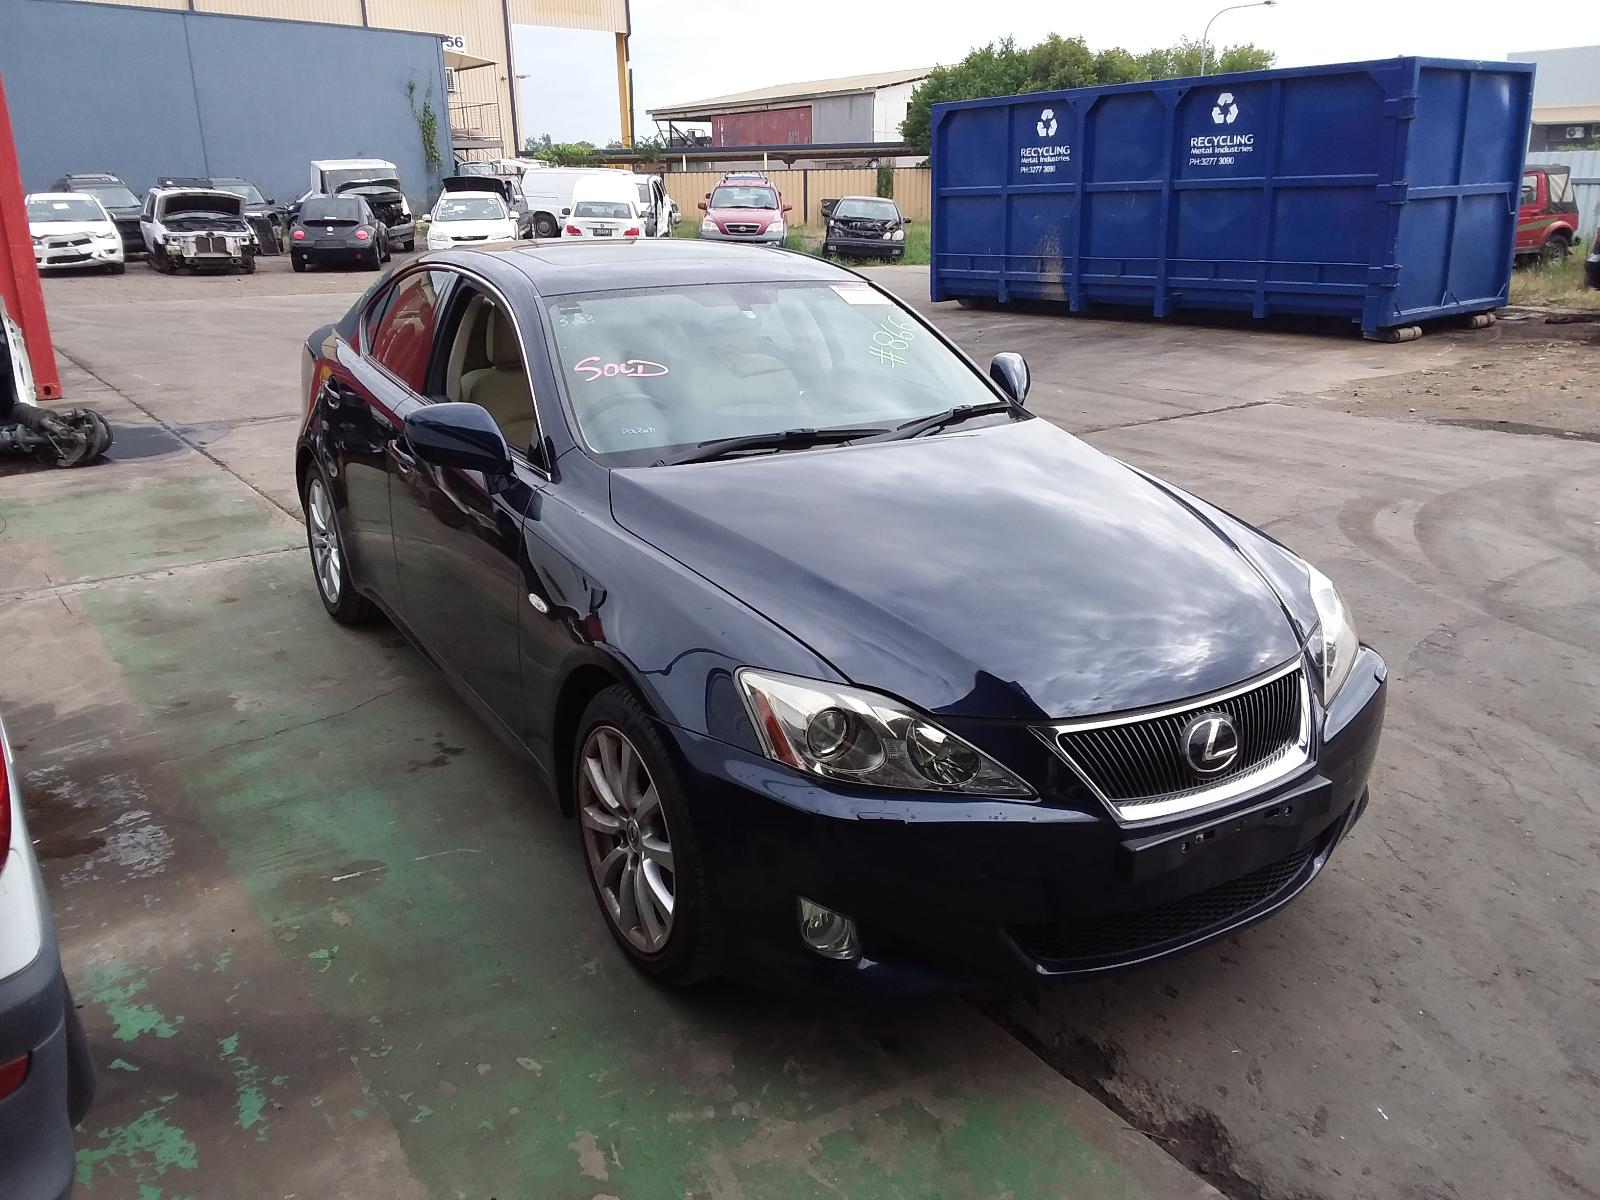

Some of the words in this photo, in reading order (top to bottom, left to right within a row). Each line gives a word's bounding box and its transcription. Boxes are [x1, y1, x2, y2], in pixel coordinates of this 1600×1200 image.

[445, 36, 463, 48] 56
[1190, 133, 1254, 147] RECYCLING
[1020, 145, 1071, 157] RECYCLING
[1190, 146, 1213, 155] Metal
[1214, 145, 1254, 154] Industries
[1020, 156, 1039, 164] Metal
[1039, 155, 1070, 163] Industries
[573, 356, 669, 382] SOLD
